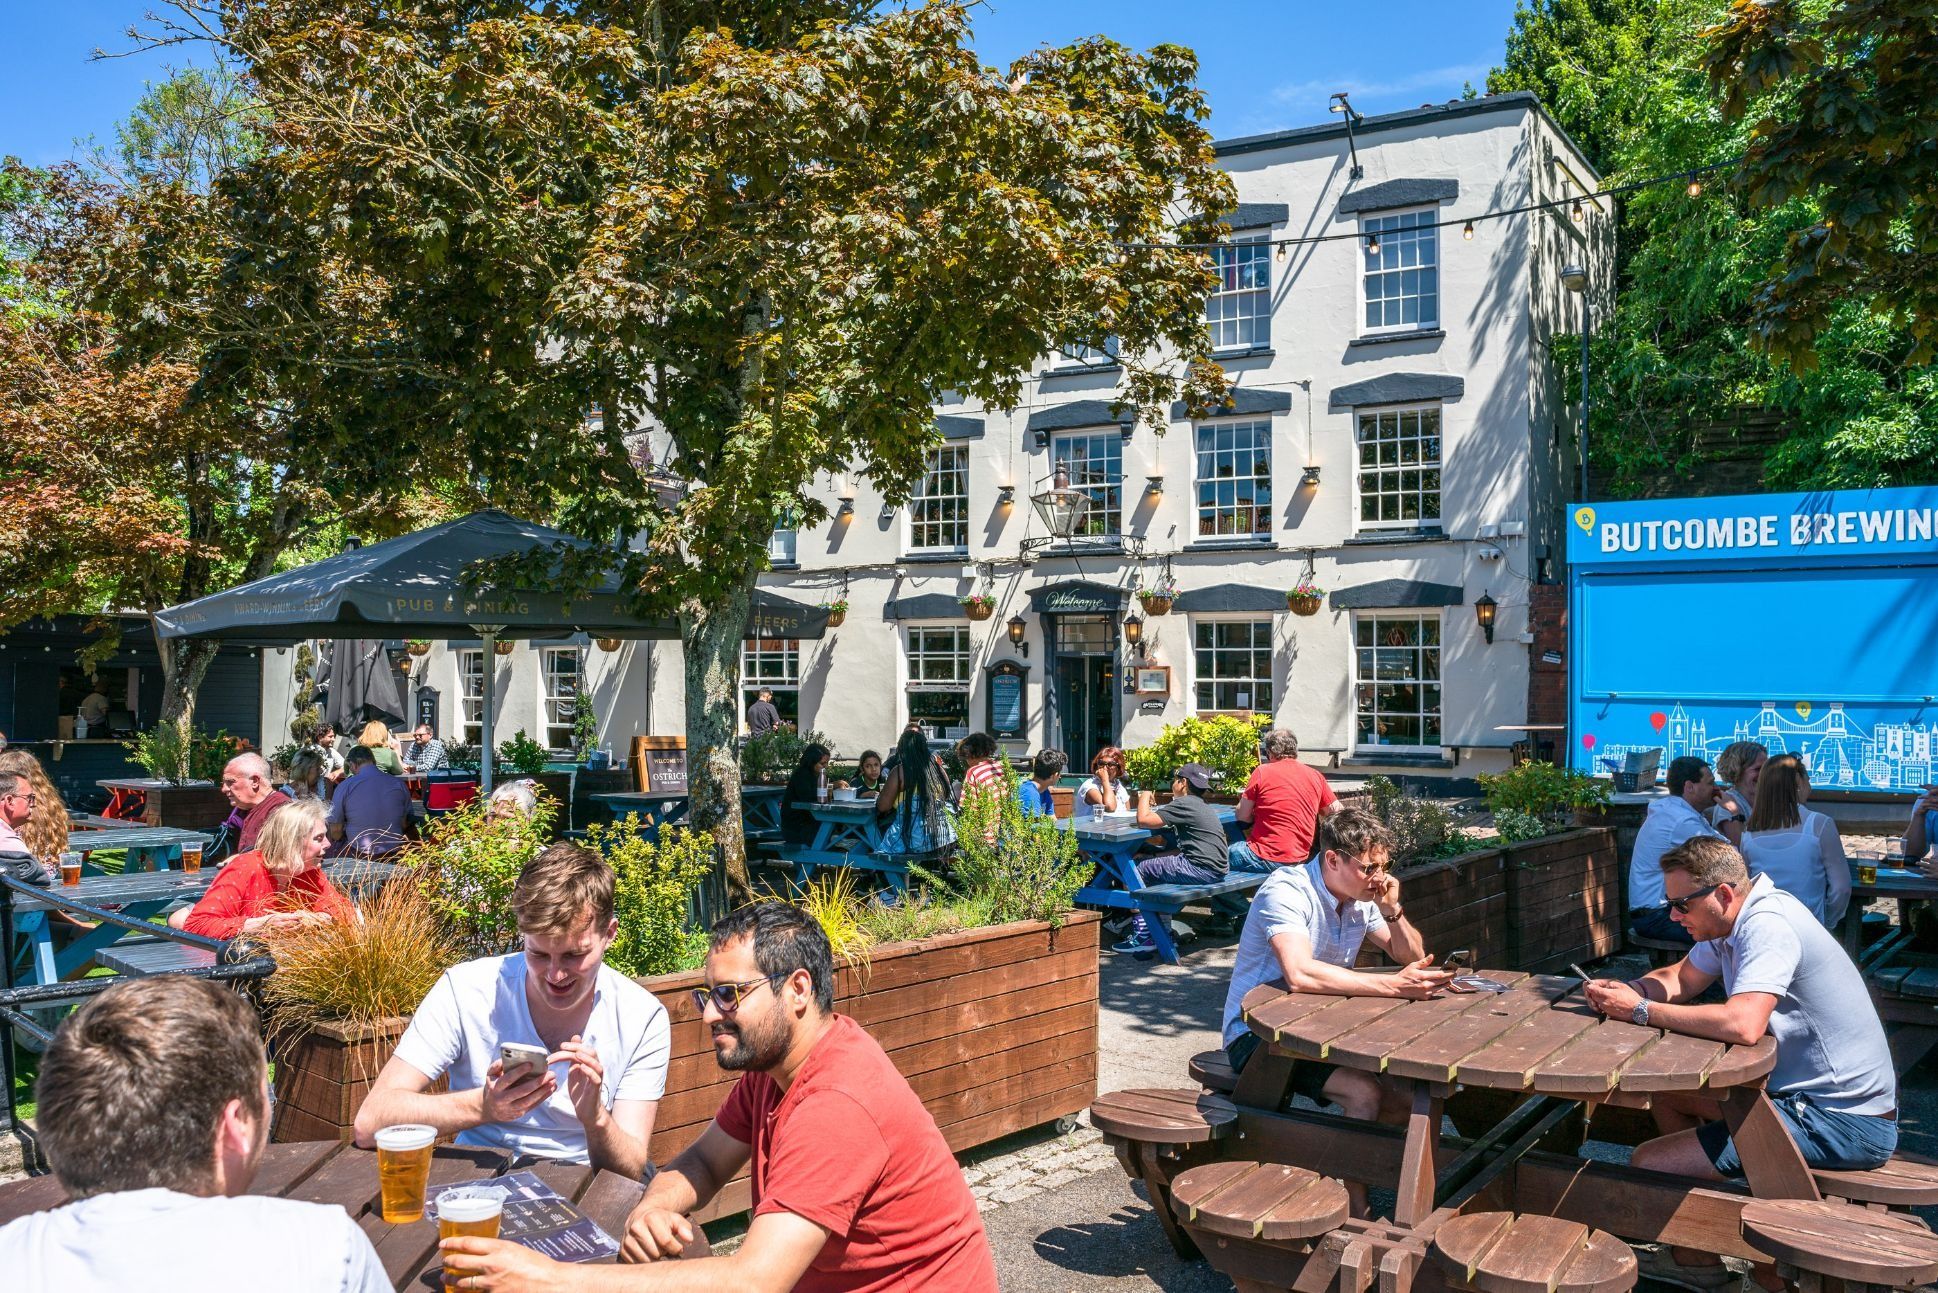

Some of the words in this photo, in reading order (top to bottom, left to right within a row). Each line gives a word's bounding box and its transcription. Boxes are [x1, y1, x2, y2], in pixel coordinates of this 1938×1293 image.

[1601, 515, 1778, 553] BUTCOMBE
[1790, 508, 1938, 546] BREWIN
[1045, 588, 1104, 609] Welcome
[396, 599, 434, 612] PUB
[443, 600, 454, 612] &
[464, 600, 529, 614] DINING
[754, 615, 799, 629] BEERS
[653, 772, 688, 781] OSTRICH
